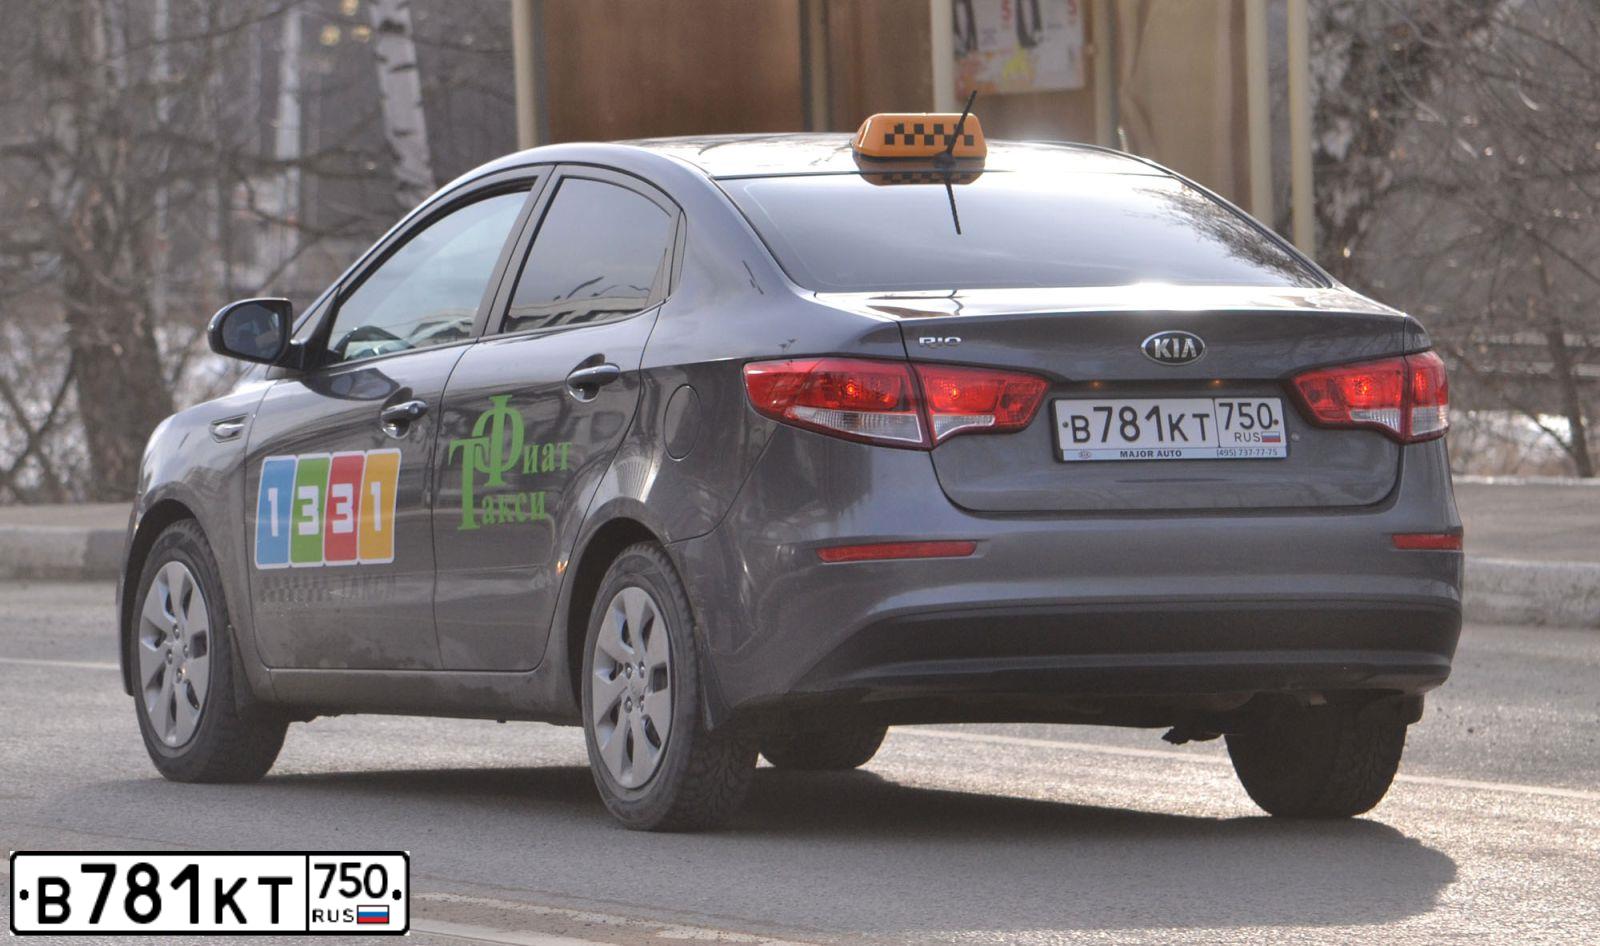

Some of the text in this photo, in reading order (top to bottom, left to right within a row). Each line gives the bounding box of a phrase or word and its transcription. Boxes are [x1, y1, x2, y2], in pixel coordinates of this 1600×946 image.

[1153, 338, 1198, 359] KIA
[1218, 402, 1274, 430] 750
[1233, 431, 1261, 443] RUS
[1119, 450, 1154, 459] MAJOR
[1156, 450, 1183, 458] AUTO
[267, 480, 382, 537] 1331
